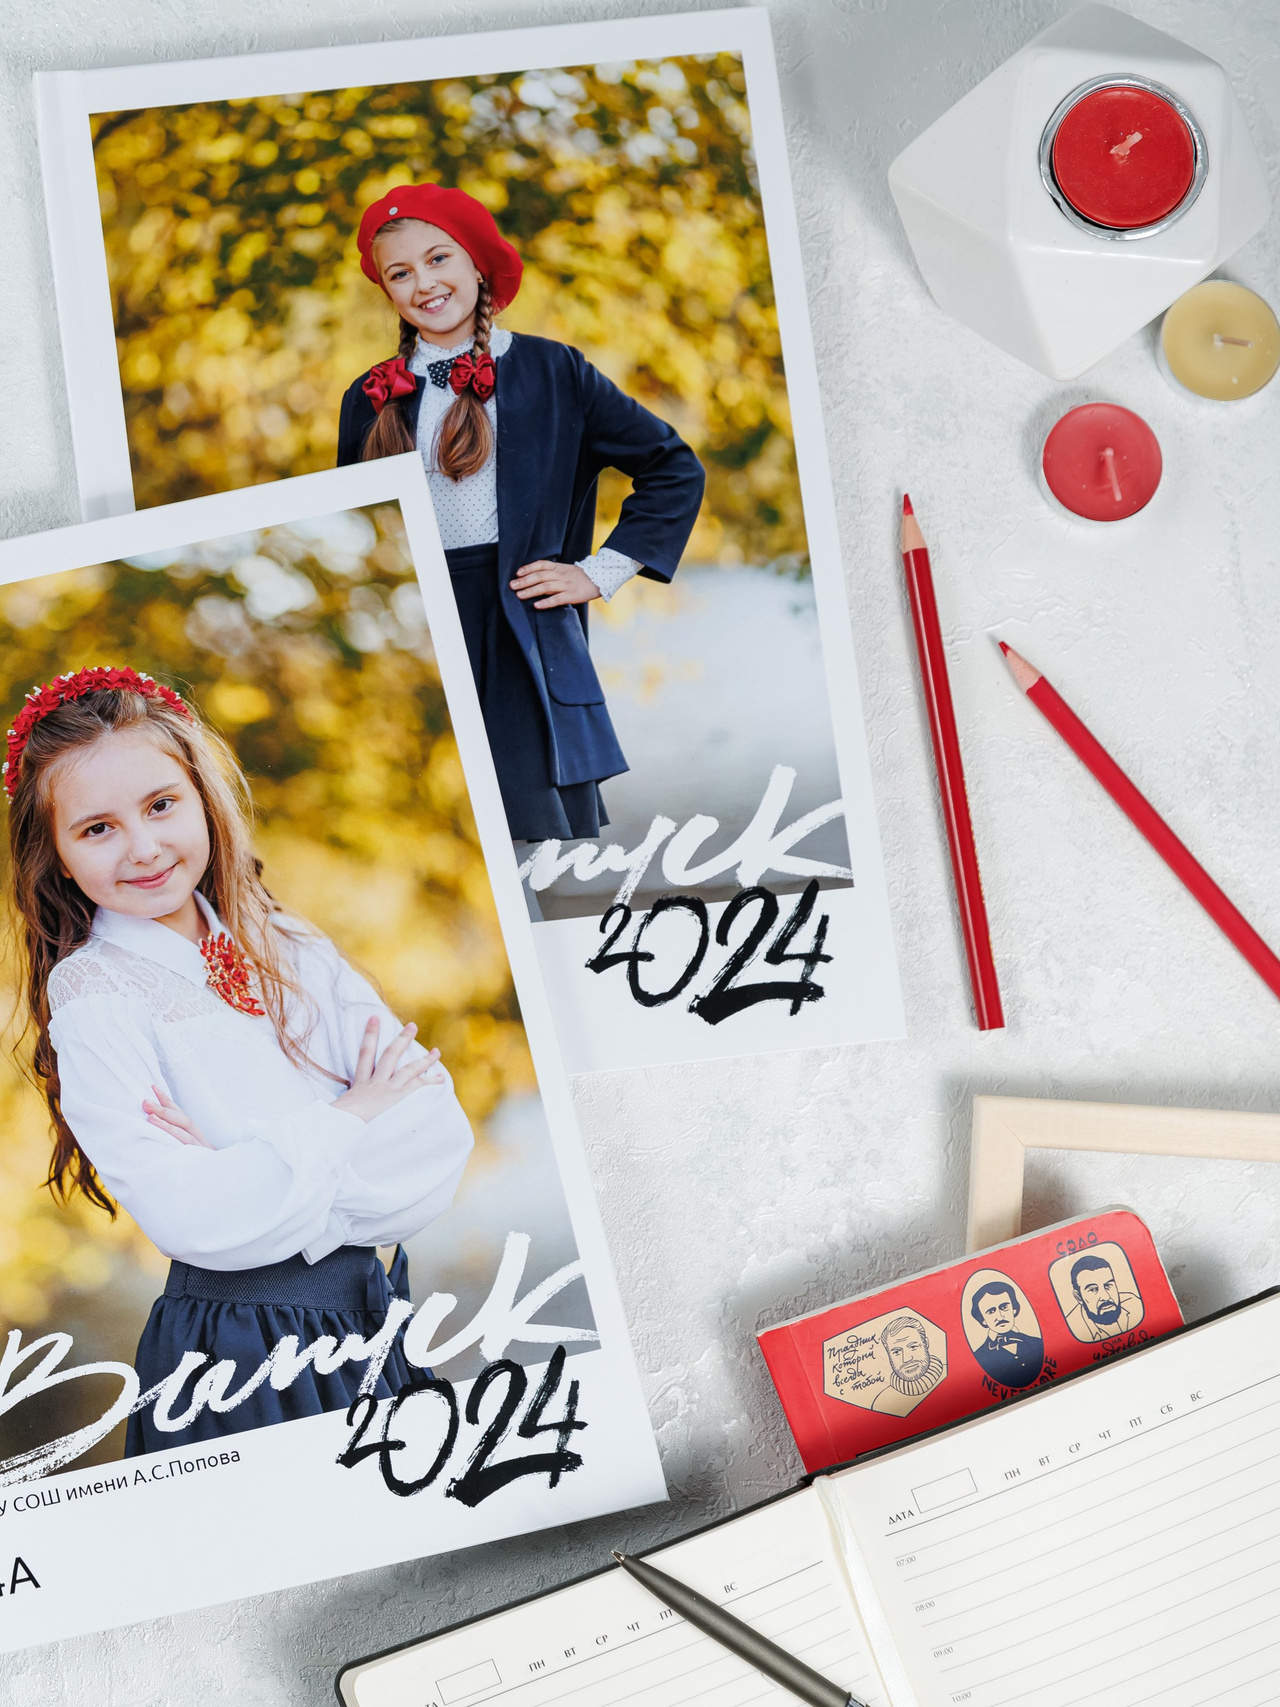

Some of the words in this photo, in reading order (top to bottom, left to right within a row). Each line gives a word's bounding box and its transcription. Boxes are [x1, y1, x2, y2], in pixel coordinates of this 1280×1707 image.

[585, 878, 833, 1026] 2024
[832, 1367, 867, 1388] всегда
[851, 1371, 885, 1392] тобой
[981, 1355, 1058, 1401] NEVEORE
[335, 1345, 589, 1508] 2024
[888, 1509, 915, 1526] ДАТА
[1004, 1468, 1022, 1481] ПН
[1038, 1455, 1052, 1467] ВТ
[1068, 1442, 1082, 1454] СР
[1098, 1429, 1113, 1441] ЧТ
[1129, 1416, 1144, 1428] ПТ
[1160, 1403, 1174, 1415] СБ
[1190, 1390, 1205, 1402] ВС
[13, 1488, 62, 1513] СОШ
[65, 1475, 129, 1502] имени
[133, 1450, 241, 1486] А.С.Попова
[896, 1555, 917, 1568] 07:00
[914, 1600, 936, 1613] 08:00
[528, 1659, 546, 1672] ПН
[564, 1647, 577, 1659] ВТ
[595, 1634, 609, 1646] СР
[626, 1621, 641, 1633] ЧТ
[723, 1581, 738, 1594] ВС
[933, 1646, 954, 1659] 09:00
[951, 1691, 972, 1703] 10:00
